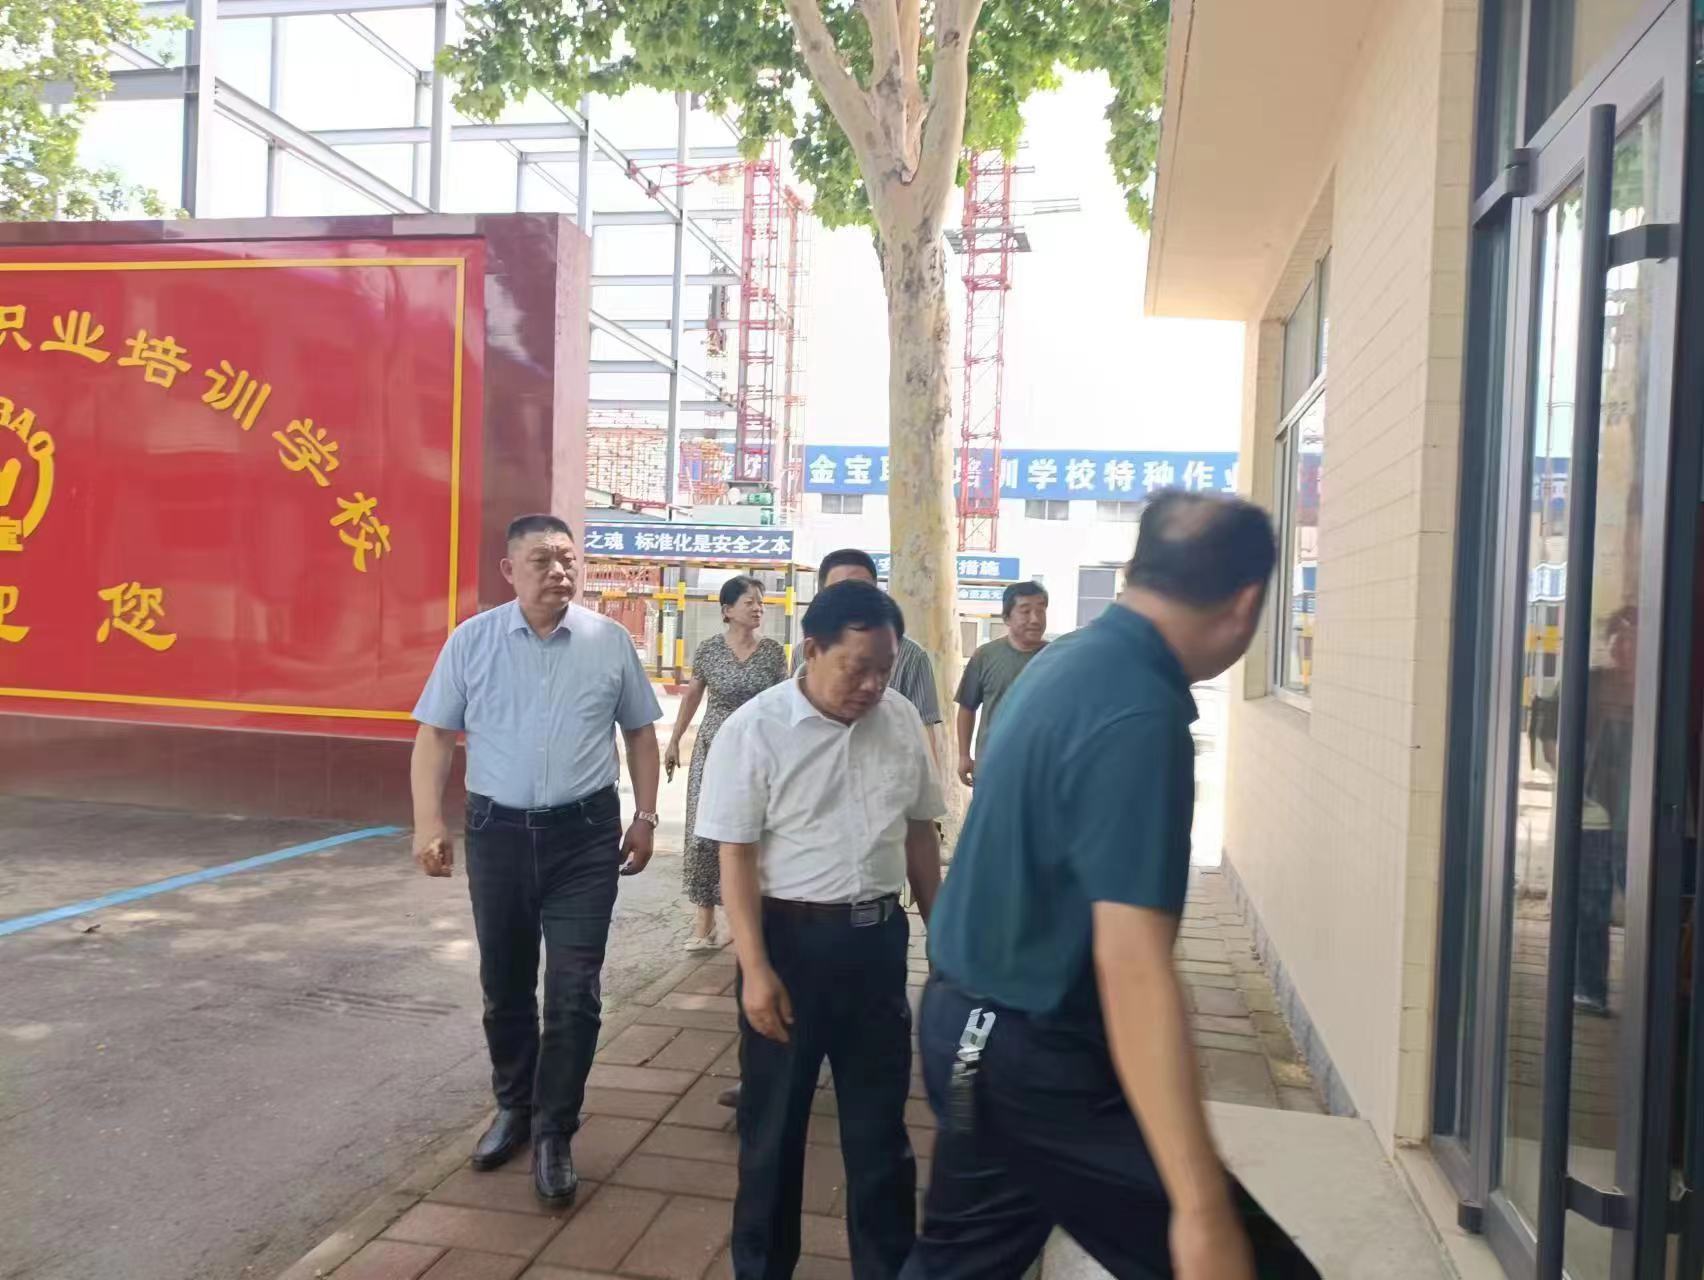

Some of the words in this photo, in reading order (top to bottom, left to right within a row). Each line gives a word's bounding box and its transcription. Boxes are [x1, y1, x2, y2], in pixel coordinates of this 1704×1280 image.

[634, 531, 791, 555] 标准化是安全之本
